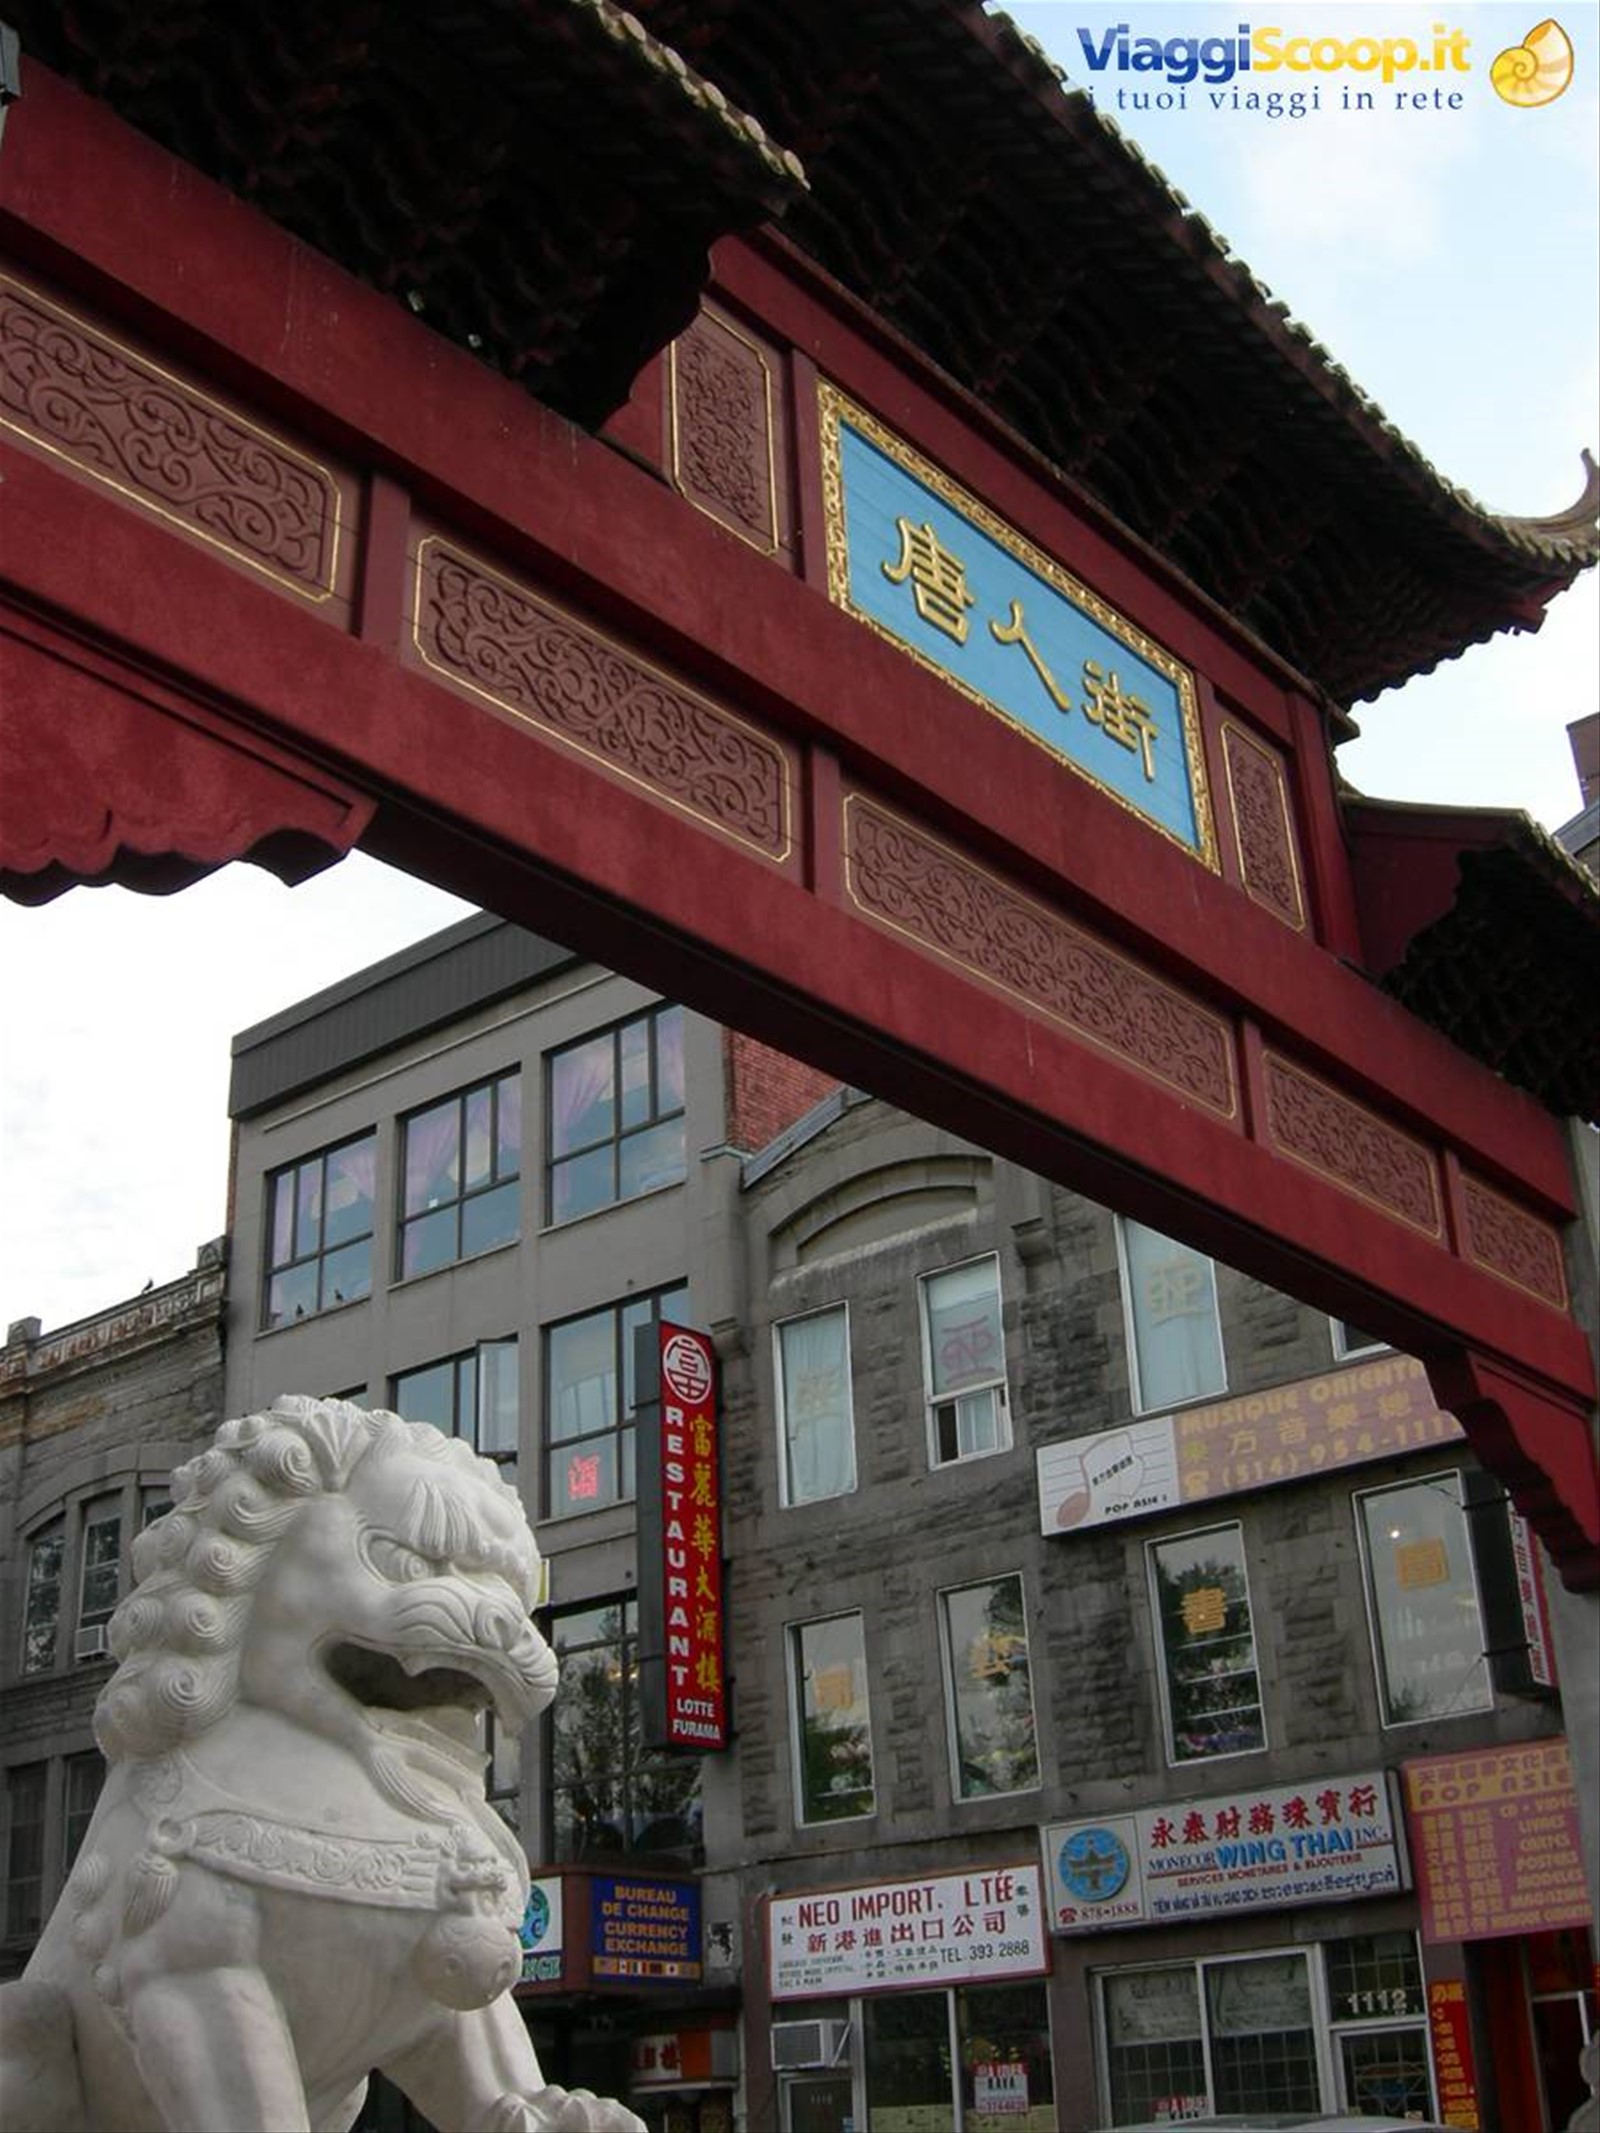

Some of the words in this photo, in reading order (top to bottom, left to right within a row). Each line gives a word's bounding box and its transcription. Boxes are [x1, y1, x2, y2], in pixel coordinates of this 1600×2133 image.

[882, 515, 1158, 783] 唐人街
[1180, 1390, 1298, 1436] MUSIQUE
[1105, 1503, 1129, 1515] POP
[664, 1406, 690, 1687] RESTAURANT
[676, 1697, 715, 1719] LOTTE
[672, 1718, 720, 1741] FURAMA
[1421, 1782, 1481, 1805] POP
[1215, 1840, 1286, 1870] WING
[1290, 1827, 1354, 1859] THAI
[1177, 1872, 1225, 1888] SERVICES
[614, 1885, 677, 1904] BUREAU
[798, 1899, 840, 1929] NEO
[965, 1869, 1014, 1908] LTÉE
[602, 1902, 622, 1917] DE
[627, 1904, 689, 1921] CHANGE
[604, 1922, 688, 1940] CURRENCY
[808, 1911, 1006, 1953] 新港進出口公司
[605, 1938, 688, 1956] EXCHANGE
[969, 1944, 994, 1960] 393
[998, 1939, 1030, 1957] 2888
[1347, 1988, 1407, 2015] 1112
